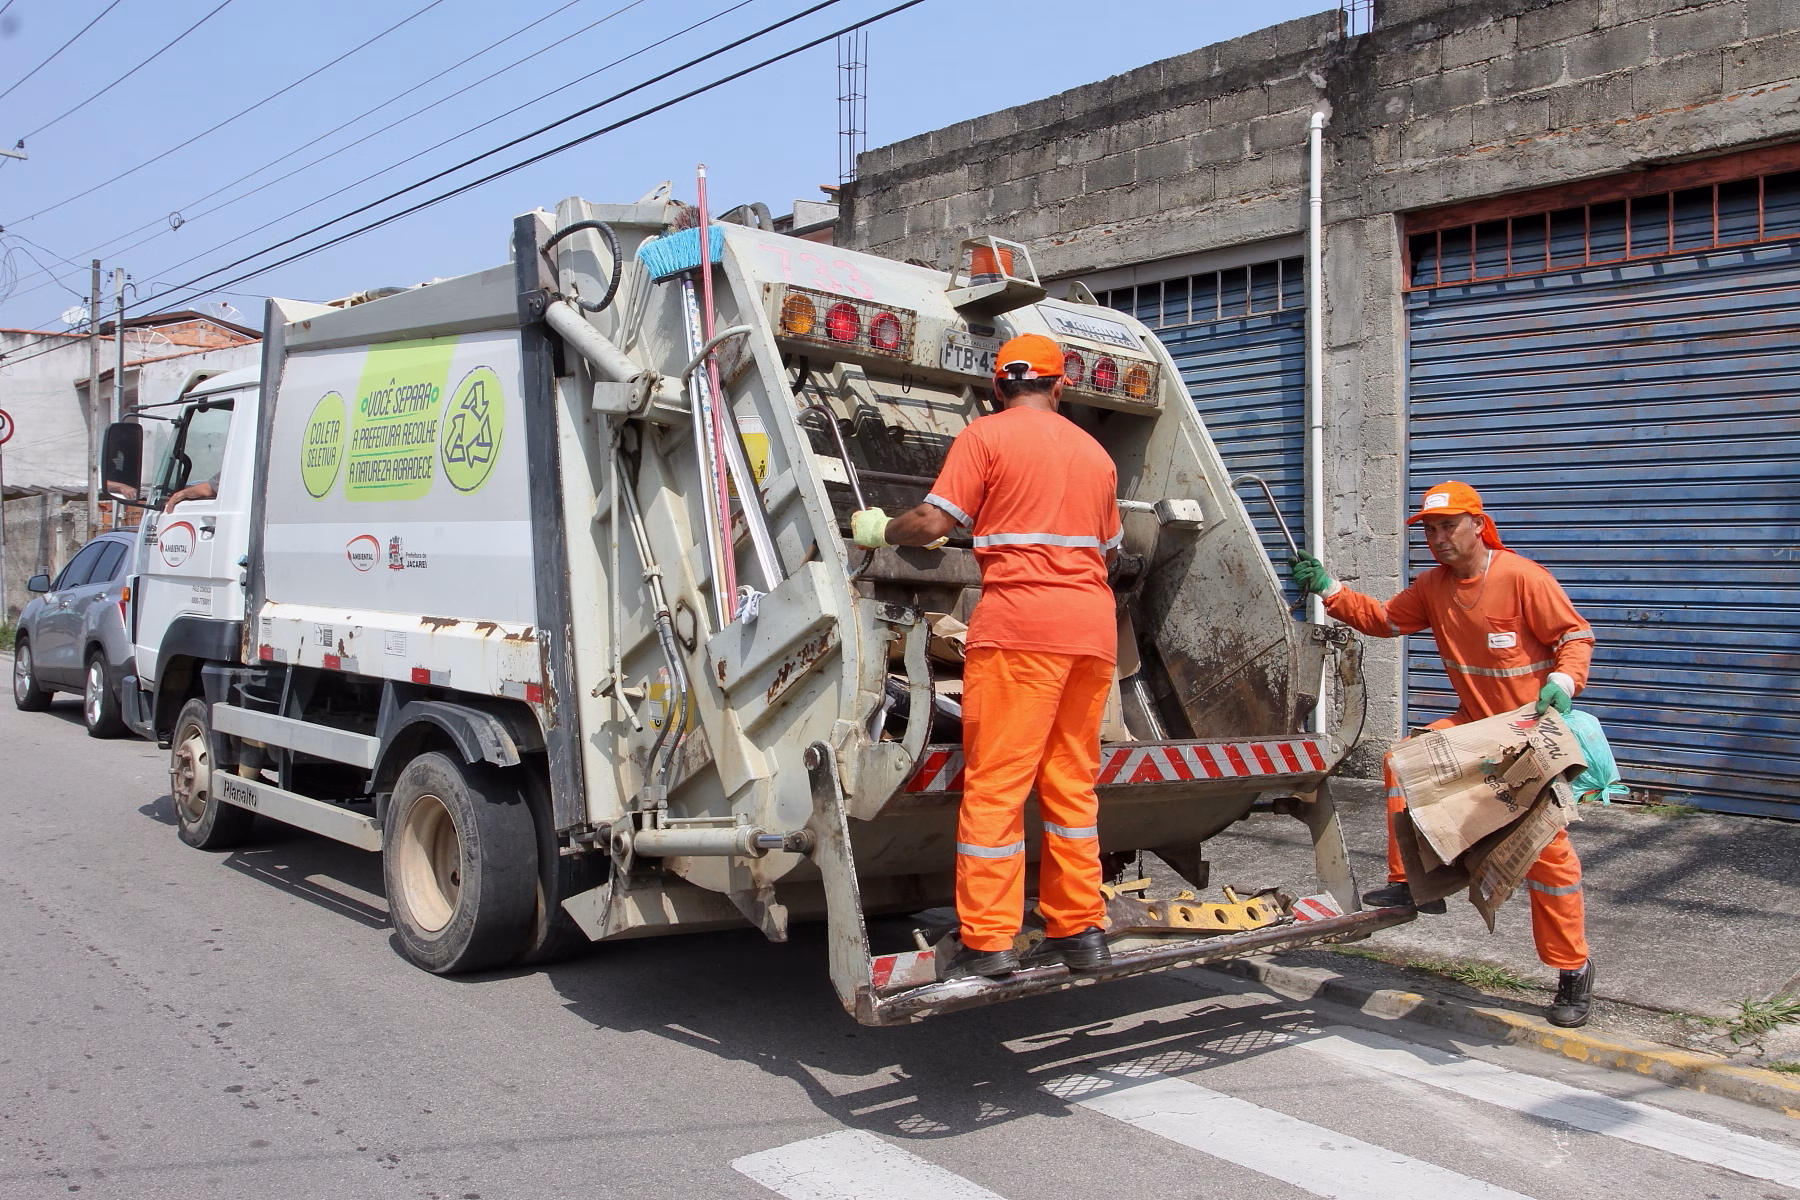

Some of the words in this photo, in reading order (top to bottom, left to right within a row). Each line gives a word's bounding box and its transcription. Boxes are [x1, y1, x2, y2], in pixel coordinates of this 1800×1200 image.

[759, 243, 876, 300] 733
[367, 377, 396, 418] VOCÊ
[392, 382, 433, 415] SEPARA
[309, 419, 341, 446] COLETA
[351, 432, 359, 451] A
[359, 424, 402, 450] PREFEITURA
[401, 419, 438, 446] RECOLHE
[306, 446, 337, 468] SELETIVA
[349, 462, 355, 484] A
[355, 457, 392, 483] NATUREZA
[391, 455, 433, 481] AGRADECE
[164, 544, 188, 553] AMBIENTAL
[352, 553, 374, 561] AMBIENTAL
[223, 780, 257, 808] Planalto
